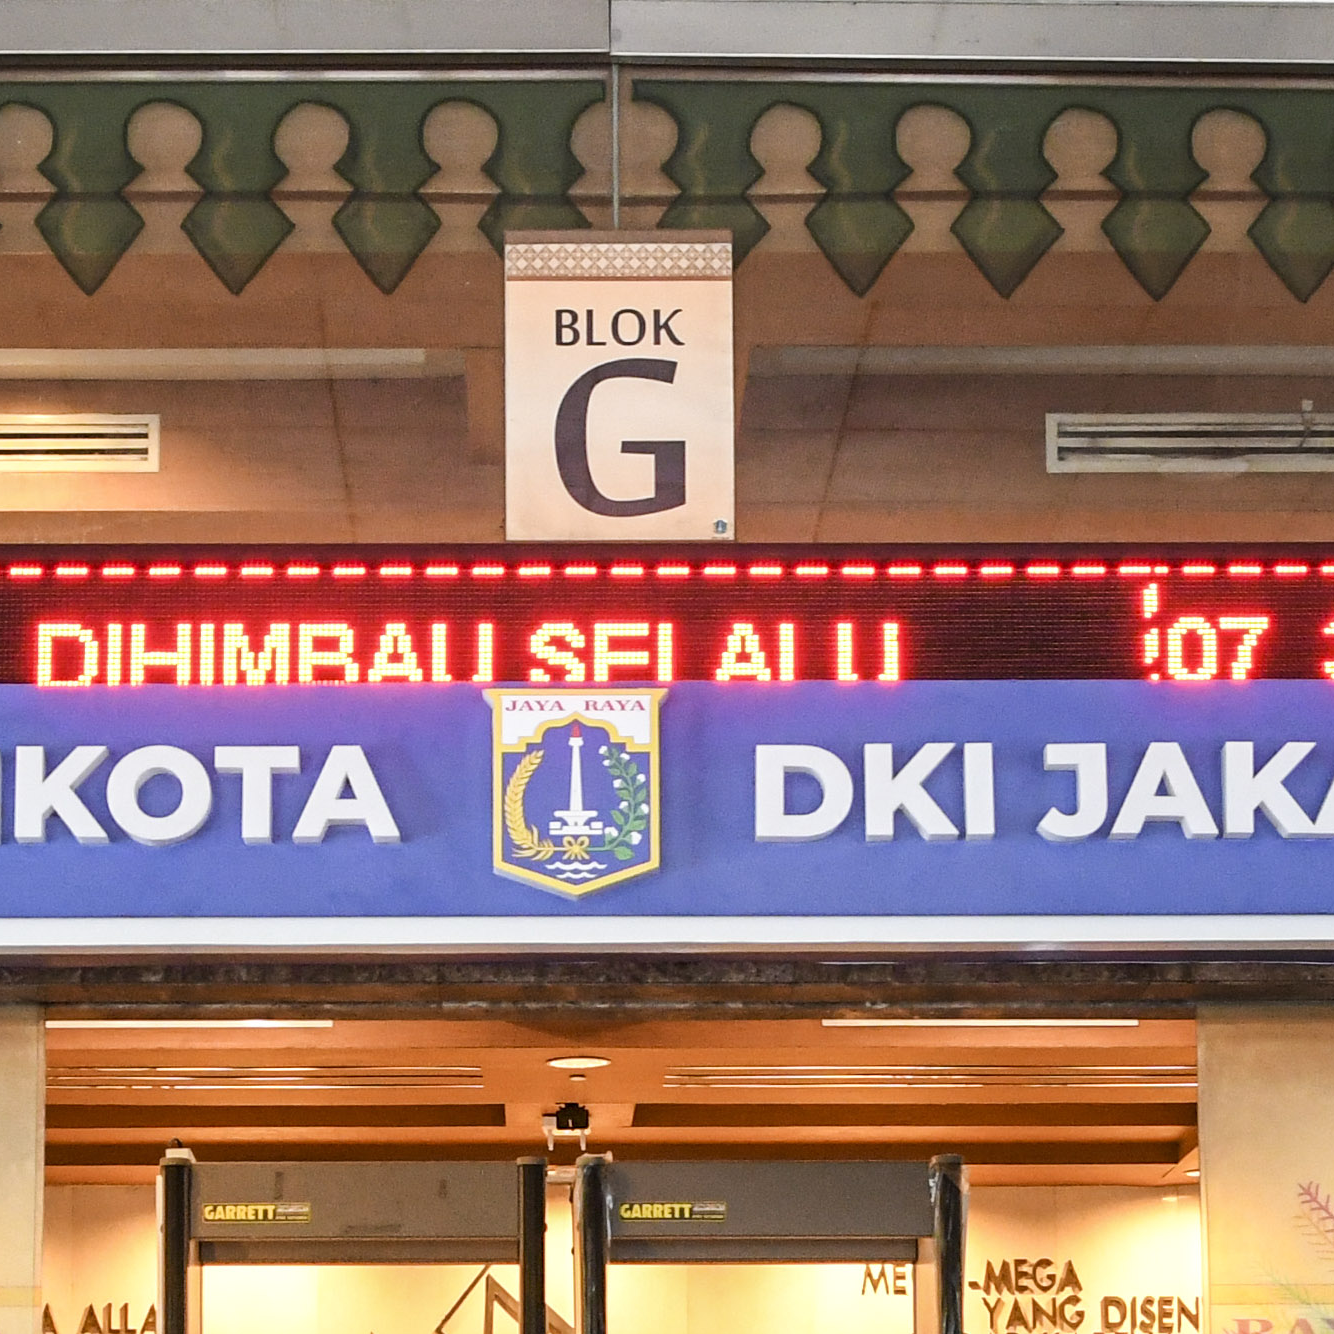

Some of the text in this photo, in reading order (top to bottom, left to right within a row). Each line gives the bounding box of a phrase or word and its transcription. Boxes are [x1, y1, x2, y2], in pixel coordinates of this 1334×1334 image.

[553, 308, 686, 348] BLOK
[553, 357, 688, 518] G
[505, 699, 646, 712] JAYA RAYA
[754, 741, 997, 843] DKI
[204, 1205, 276, 1220] GARRETT
[620, 1204, 692, 1219] GARRETT
[982, 1295, 1200, 1333] YANG DISEN
